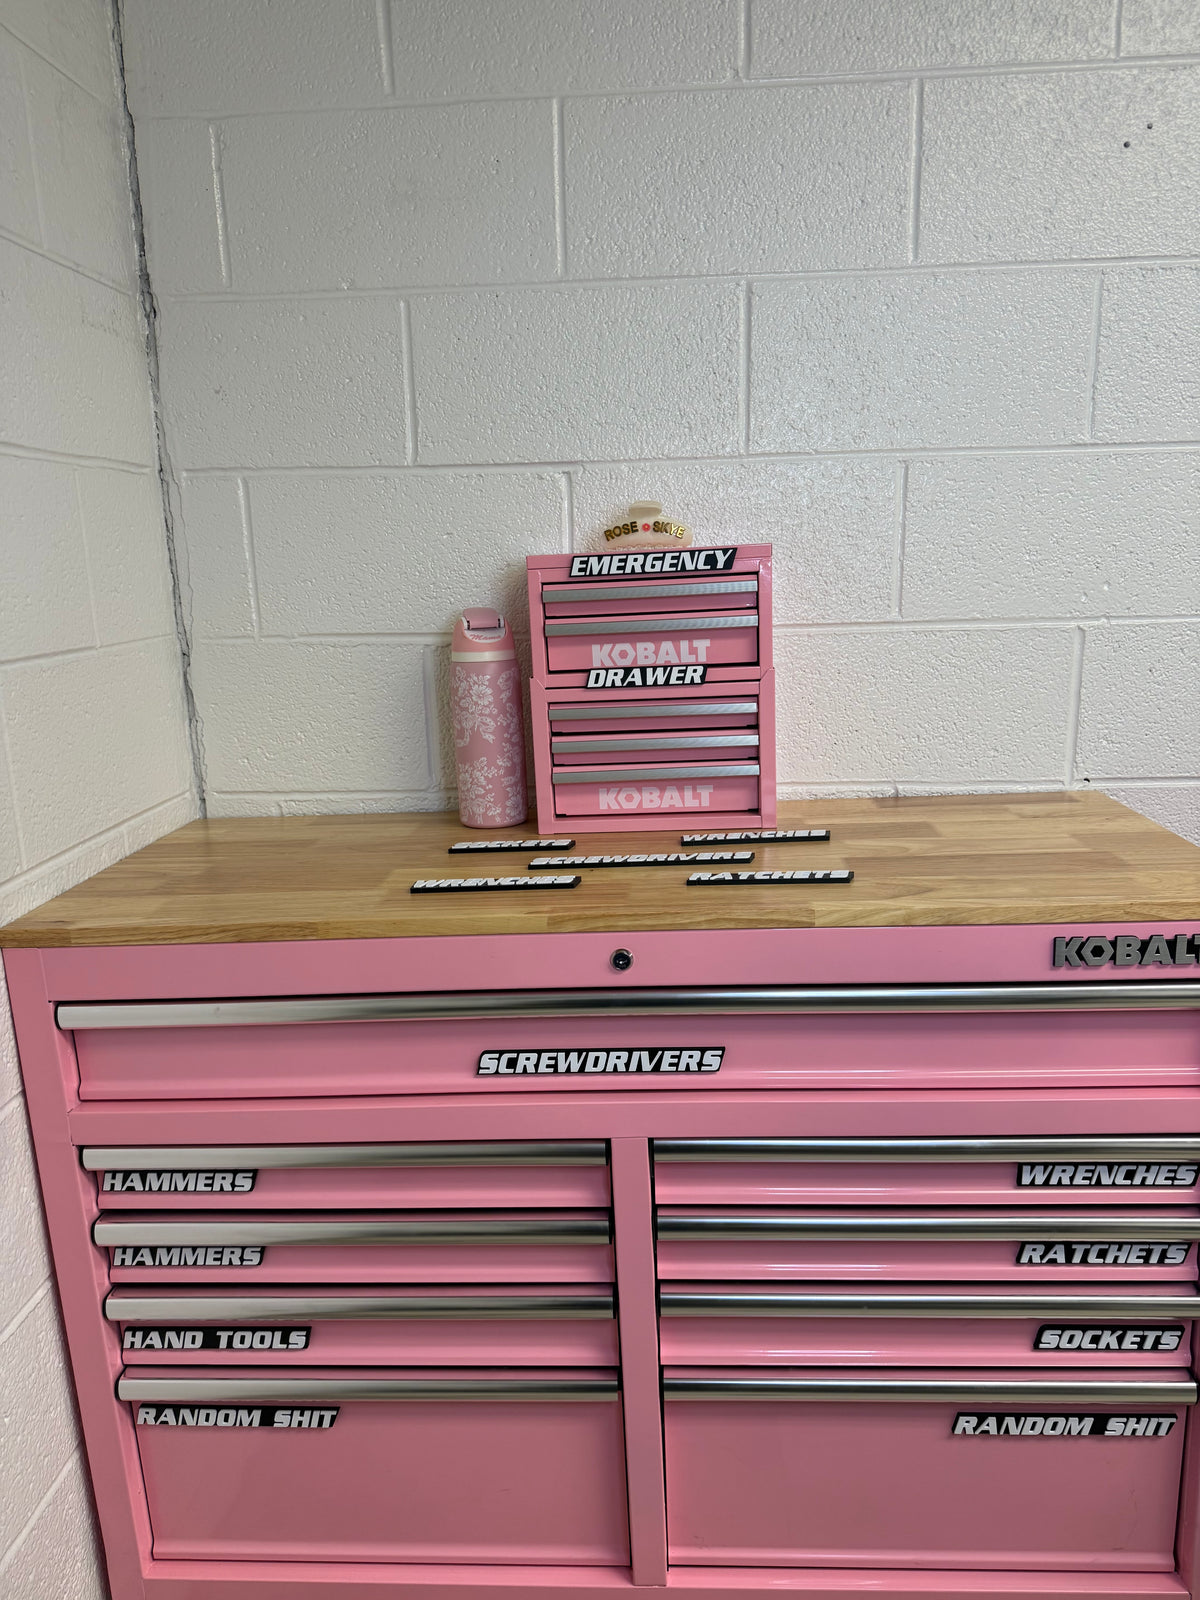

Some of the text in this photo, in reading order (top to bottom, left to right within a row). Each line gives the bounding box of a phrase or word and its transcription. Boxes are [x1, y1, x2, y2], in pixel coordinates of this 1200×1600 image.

[604, 521, 686, 542] ROSE SKYE
[570, 549, 733, 577] EMERGENCY
[591, 638, 711, 667] KOBALT
[587, 665, 704, 688] DRAWER
[599, 785, 714, 810] KOBALT
[451, 839, 572, 849] SOCKETS
[682, 829, 827, 842] WRENCHES
[530, 851, 753, 865] SCREWDRIVERS
[413, 875, 576, 888] WRENCHES
[688, 869, 850, 881] RATCHETS
[1053, 934, 1200, 967] KOBAL
[478, 1050, 723, 1074] SCREWDRIVERS
[102, 1171, 254, 1192] HAMMERS
[1020, 1164, 1198, 1186] WRENCHES
[113, 1246, 263, 1266] HAMMERS
[1019, 1243, 1188, 1264] RATCHETS
[123, 1330, 307, 1349] HAND TOOLS
[1038, 1329, 1182, 1350] SOCKETS
[136, 1407, 338, 1428] RANDOM SHIT
[953, 1415, 1177, 1437] RANDOM SHIT
